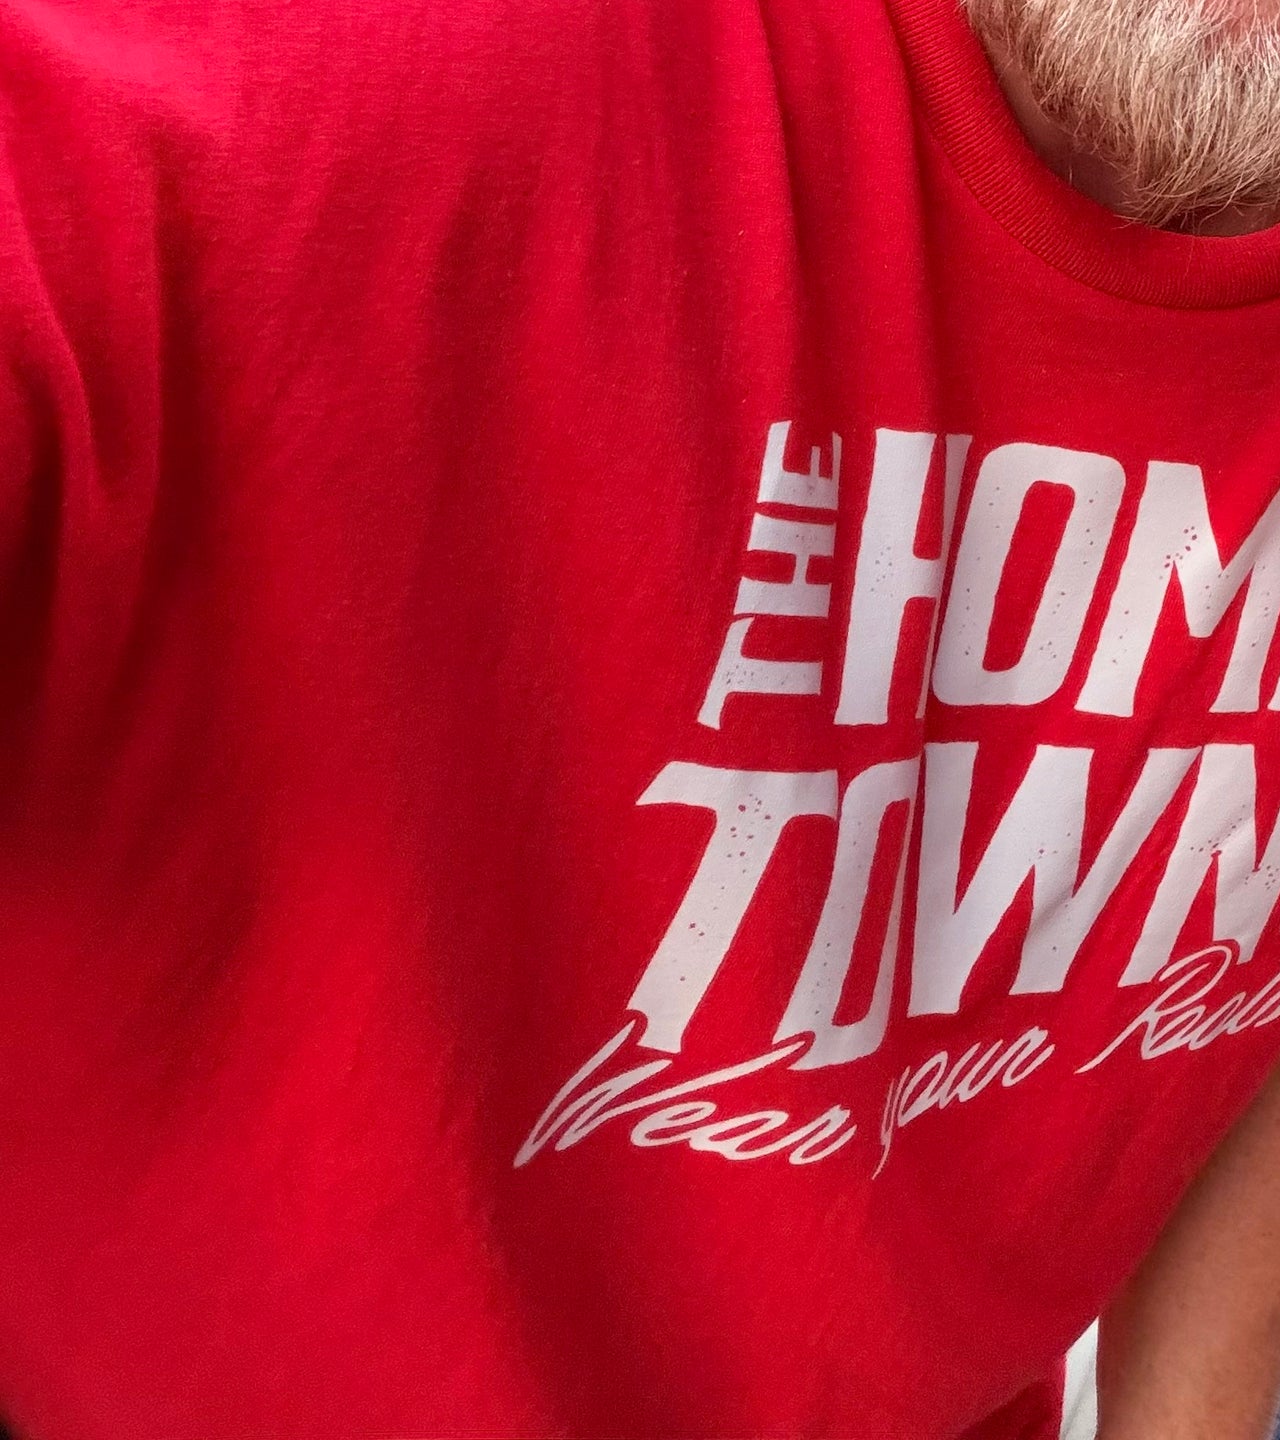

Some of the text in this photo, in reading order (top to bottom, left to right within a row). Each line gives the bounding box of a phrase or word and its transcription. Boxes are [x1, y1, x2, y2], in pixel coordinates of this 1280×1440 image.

[697, 419, 843, 730] THE
[513, 1010, 858, 1169] Wear
[870, 1026, 1056, 1180] your
